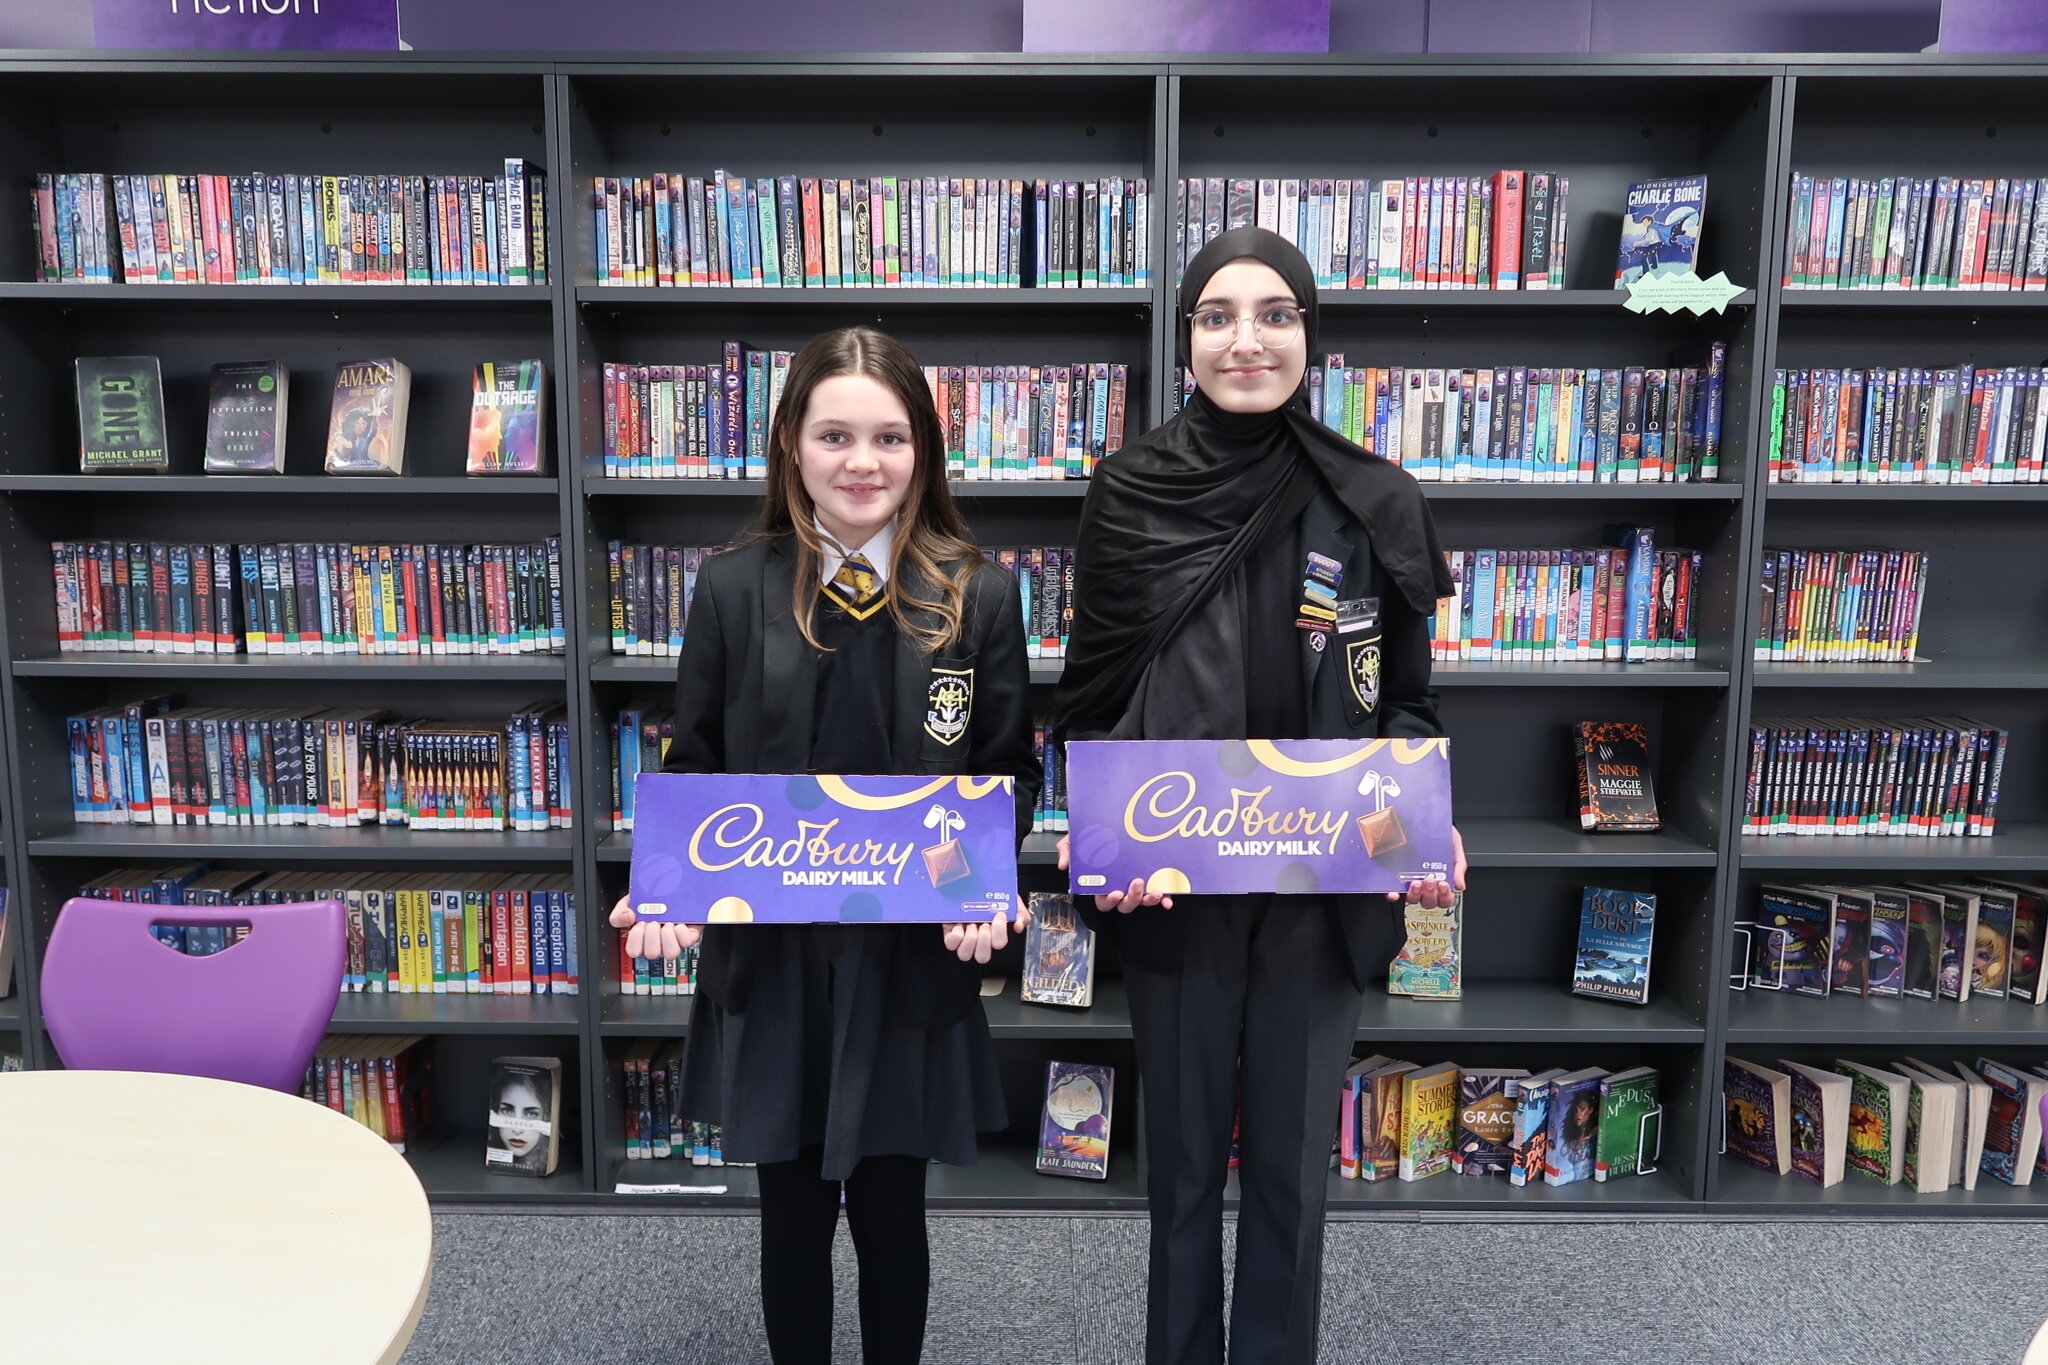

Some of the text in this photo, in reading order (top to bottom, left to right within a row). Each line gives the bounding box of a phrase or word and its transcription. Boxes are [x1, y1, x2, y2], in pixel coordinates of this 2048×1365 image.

[1636, 182, 1678, 190] MIDNIGHT
[1673, 186, 1701, 202] BONE
[326, 181, 336, 221] BOMBS
[510, 179, 522, 229] PACE BAND
[271, 195, 284, 239] ROAR
[472, 193, 483, 236] TANT CITY
[900, 214, 908, 253] DARKSIDE
[338, 365, 393, 388] AMARI
[498, 381, 515, 390] THE
[101, 376, 141, 443] GONE
[212, 406, 273, 414] EXTINCTION
[1096, 394, 1106, 413] GOOD
[1344, 395, 1352, 429] PRATCHETT
[608, 421, 616, 448] HAMILTON
[698, 417, 706, 441] SUZANNE
[1095, 414, 1106, 437] HAWK
[1494, 417, 1503, 431] Lights
[87, 449, 162, 460] MICHAEL GRANT
[1872, 433, 1880, 461] DARKNESS
[1967, 433, 1976, 461] GHOST
[242, 560, 258, 580] IES
[1313, 555, 1335, 569] BUDDY
[1315, 567, 1335, 577] STUDENT
[152, 565, 167, 595] AGUE
[195, 560, 209, 595] UNGER
[214, 561, 231, 590] IGHT
[262, 561, 278, 591] IGHT
[318, 576, 327, 597] EDEN
[430, 567, 438, 587] BOY
[550, 564, 561, 588] IDIOTS
[69, 582, 77, 603] MOON
[383, 578, 392, 604] TOWER
[284, 589, 294, 634] MICHAEL GRAN
[611, 599, 623, 629] LIFTERS
[1580, 590, 1589, 636] FIRST LIGHT
[129, 720, 141, 757] NESS
[305, 755, 315, 774] EVER
[1597, 763, 1639, 776] SINNER
[237, 759, 246, 798] REQUIEM
[251, 760, 261, 800] DELIRIUM
[306, 775, 317, 800] YOURS
[1579, 759, 1589, 799] SINNER
[1600, 779, 1642, 789] MAGGIE
[1045, 784, 1054, 805] SAVVY
[1600, 788, 1643, 796] STIEFVATER
[1124, 770, 1349, 855] Cadbury
[688, 803, 915, 885] Cadbury
[1217, 840, 1322, 856] DAIRY MILK
[782, 870, 888, 886] DAIRY MILK
[495, 906, 512, 967] contagion
[513, 905, 528, 965] evolution
[549, 905, 564, 966] deception
[1411, 921, 1449, 932] SPRINKLE
[1592, 915, 1640, 935] DUST
[1414, 937, 1449, 946] SORCERY
[1614, 941, 1643, 950] SAUVAGE
[1576, 981, 1641, 997] PHILIP PULLMAN
[1418, 1081, 1458, 1105] SUMMER
[1607, 1088, 1655, 1119] MEDUSA
[1417, 1097, 1457, 1116] STORIES
[1041, 1158, 1059, 1167] KATE
